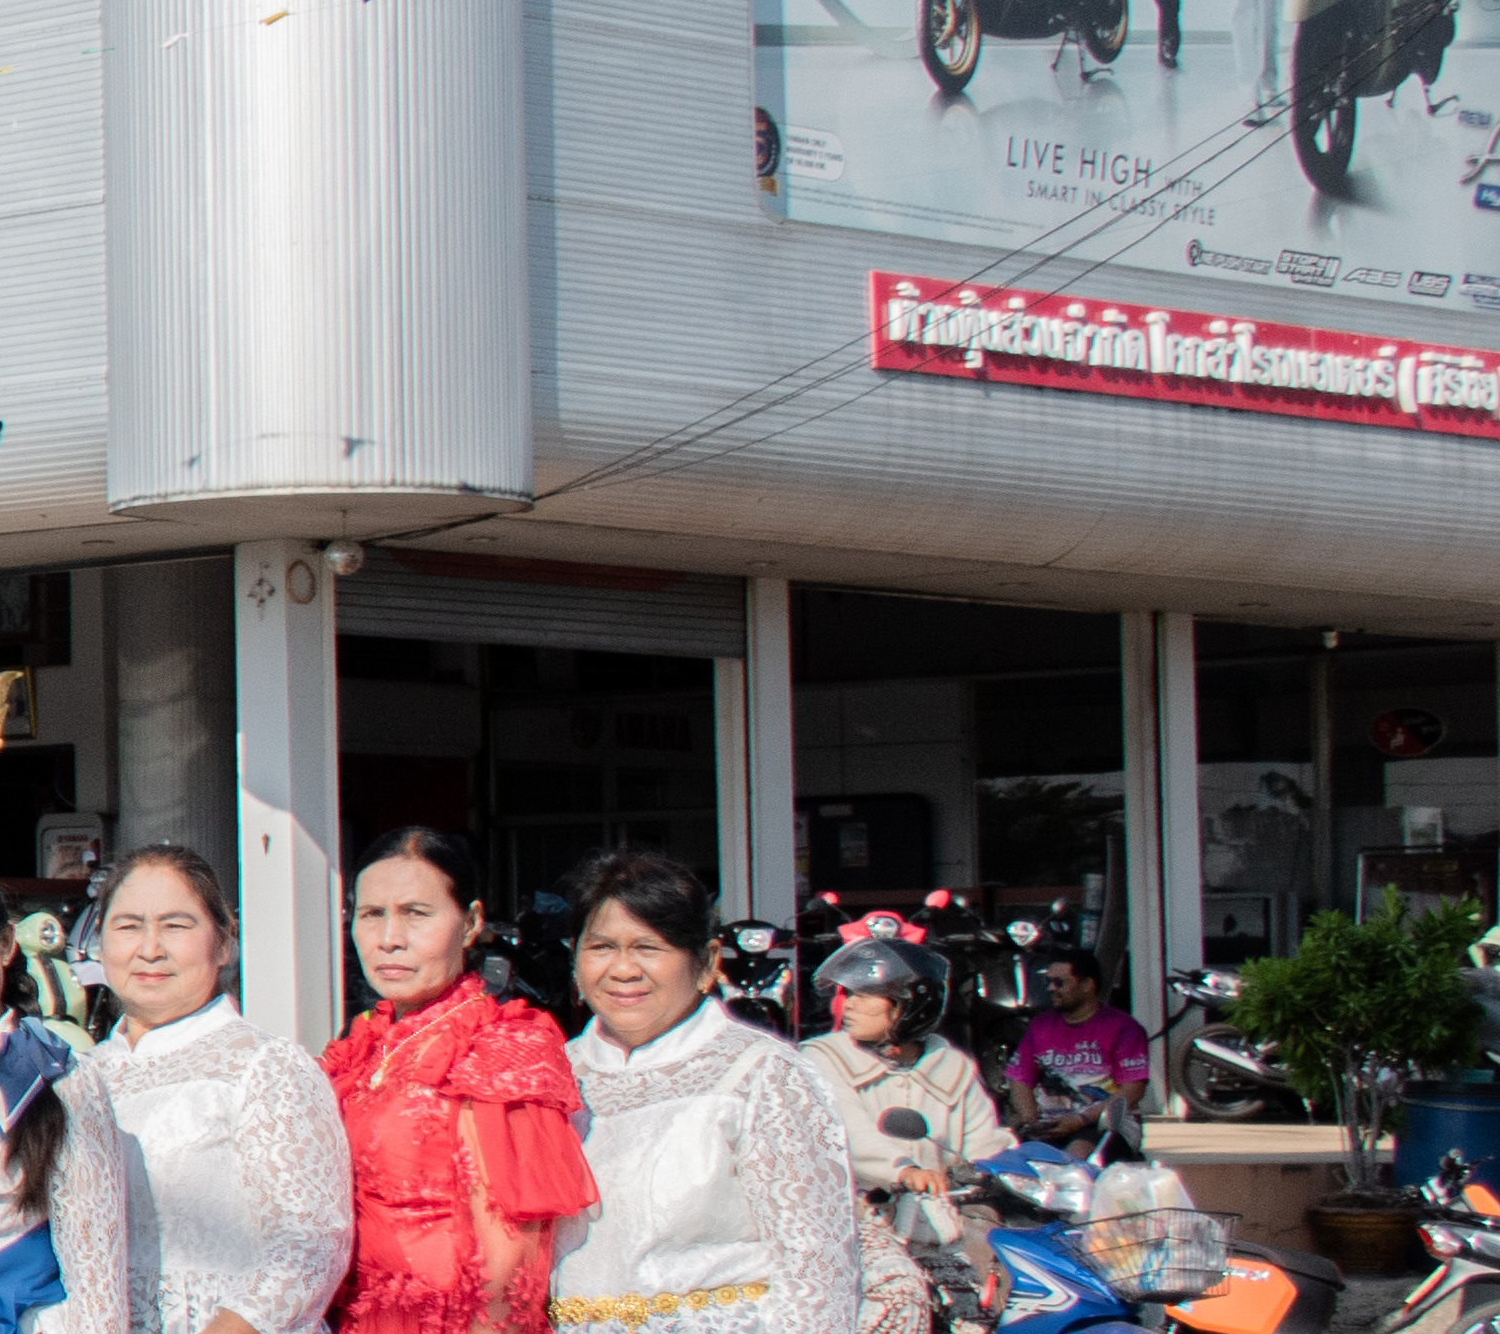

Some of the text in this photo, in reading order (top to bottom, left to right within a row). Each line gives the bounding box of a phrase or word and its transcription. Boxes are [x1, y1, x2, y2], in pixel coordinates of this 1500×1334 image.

[1006, 136, 1067, 174] LIVE
[1078, 148, 1151, 188] HIGH
[1026, 180, 1078, 204] SMART
[1172, 203, 1216, 227] STYLE
